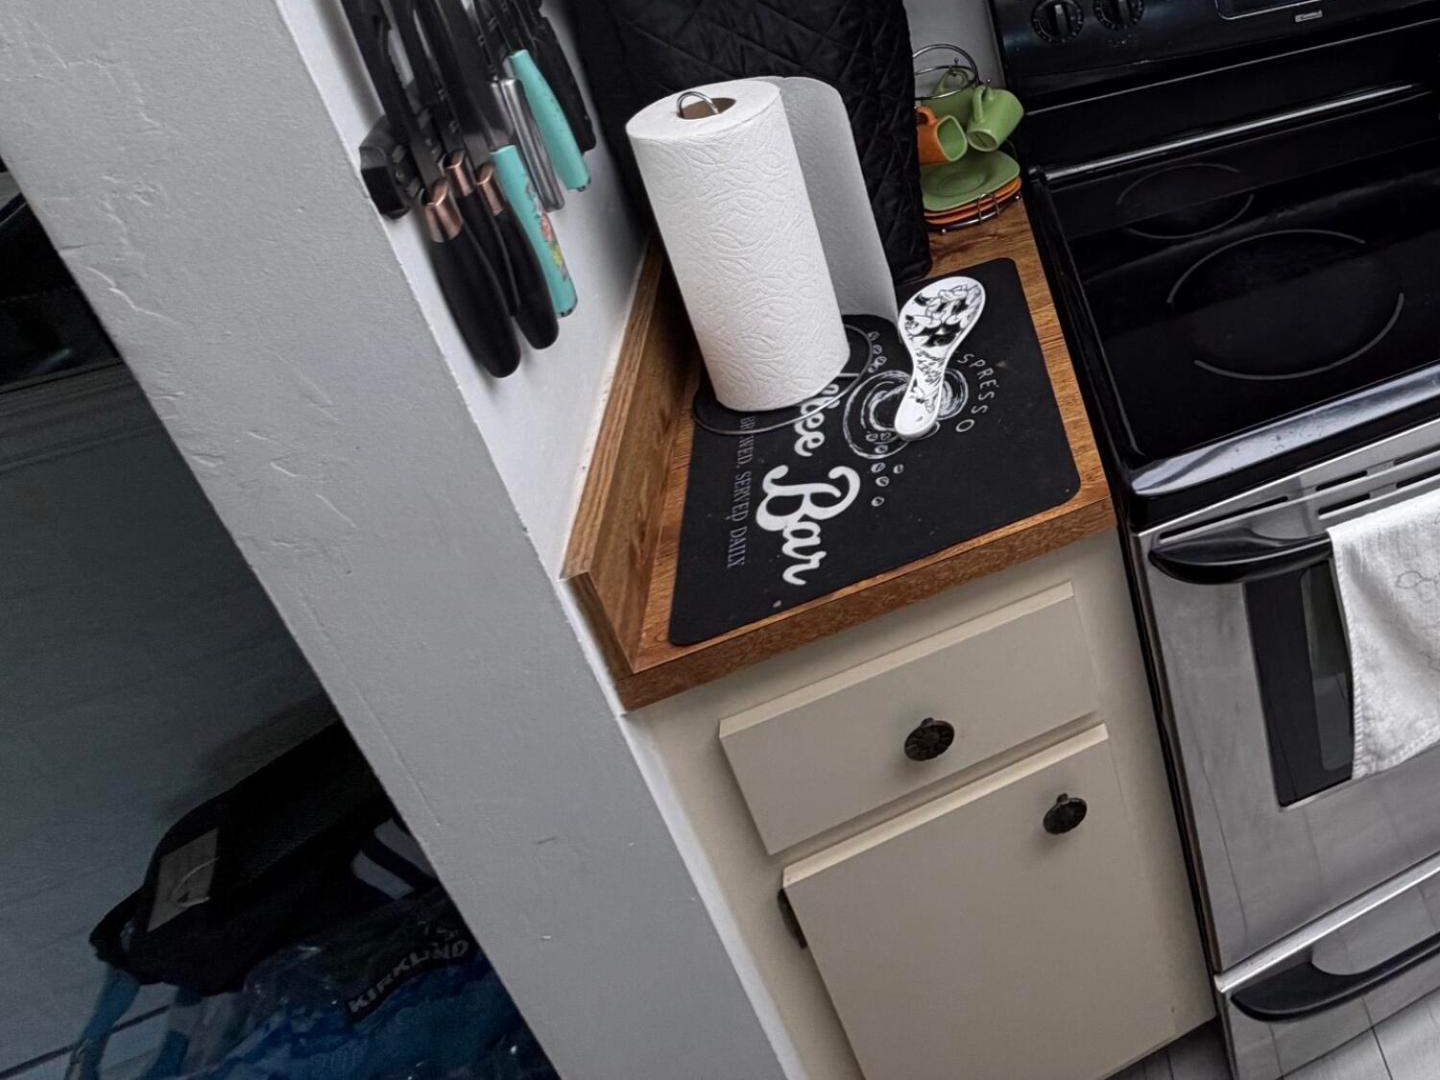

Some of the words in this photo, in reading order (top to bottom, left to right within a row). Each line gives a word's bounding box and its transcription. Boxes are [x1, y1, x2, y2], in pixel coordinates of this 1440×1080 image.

[794, 383, 840, 457] fee
[956, 353, 995, 433] SPRESSO
[736, 417, 755, 470] BRWED.
[732, 471, 753, 528] SERVED
[756, 465, 861, 586] Bar
[727, 526, 748, 569] DAILY
